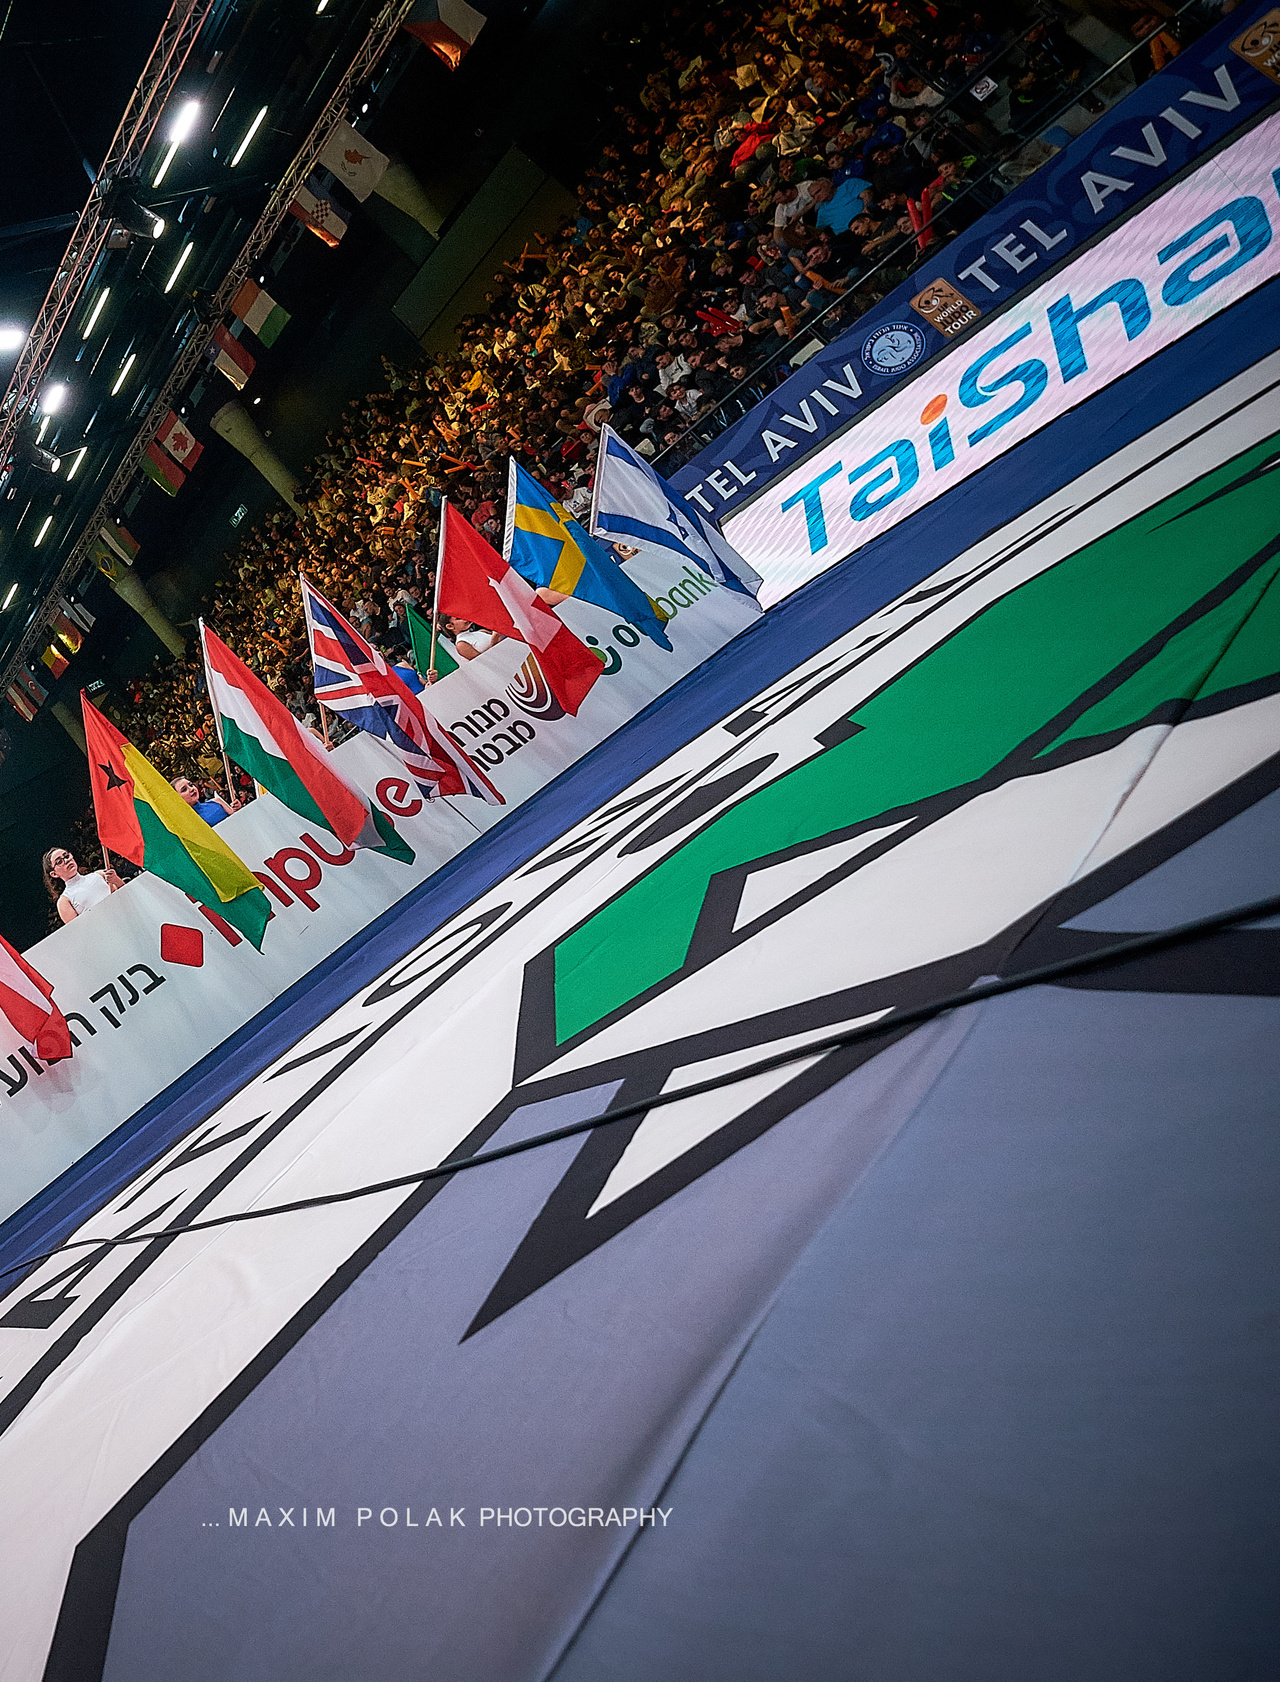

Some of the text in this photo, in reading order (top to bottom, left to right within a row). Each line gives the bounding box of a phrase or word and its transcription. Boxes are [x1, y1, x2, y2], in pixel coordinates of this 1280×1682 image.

[957, 63, 1242, 293] TEL AVIV
[934, 300, 963, 323] WORLD
[940, 305, 969, 329] JUDO
[945, 310, 977, 335] TOUR
[781, 166, 1280, 555] TaiSha
[891, 363, 907, 373] JUDO
[684, 363, 864, 514] TEL AVIV
[89, 963, 167, 1029] בנק
